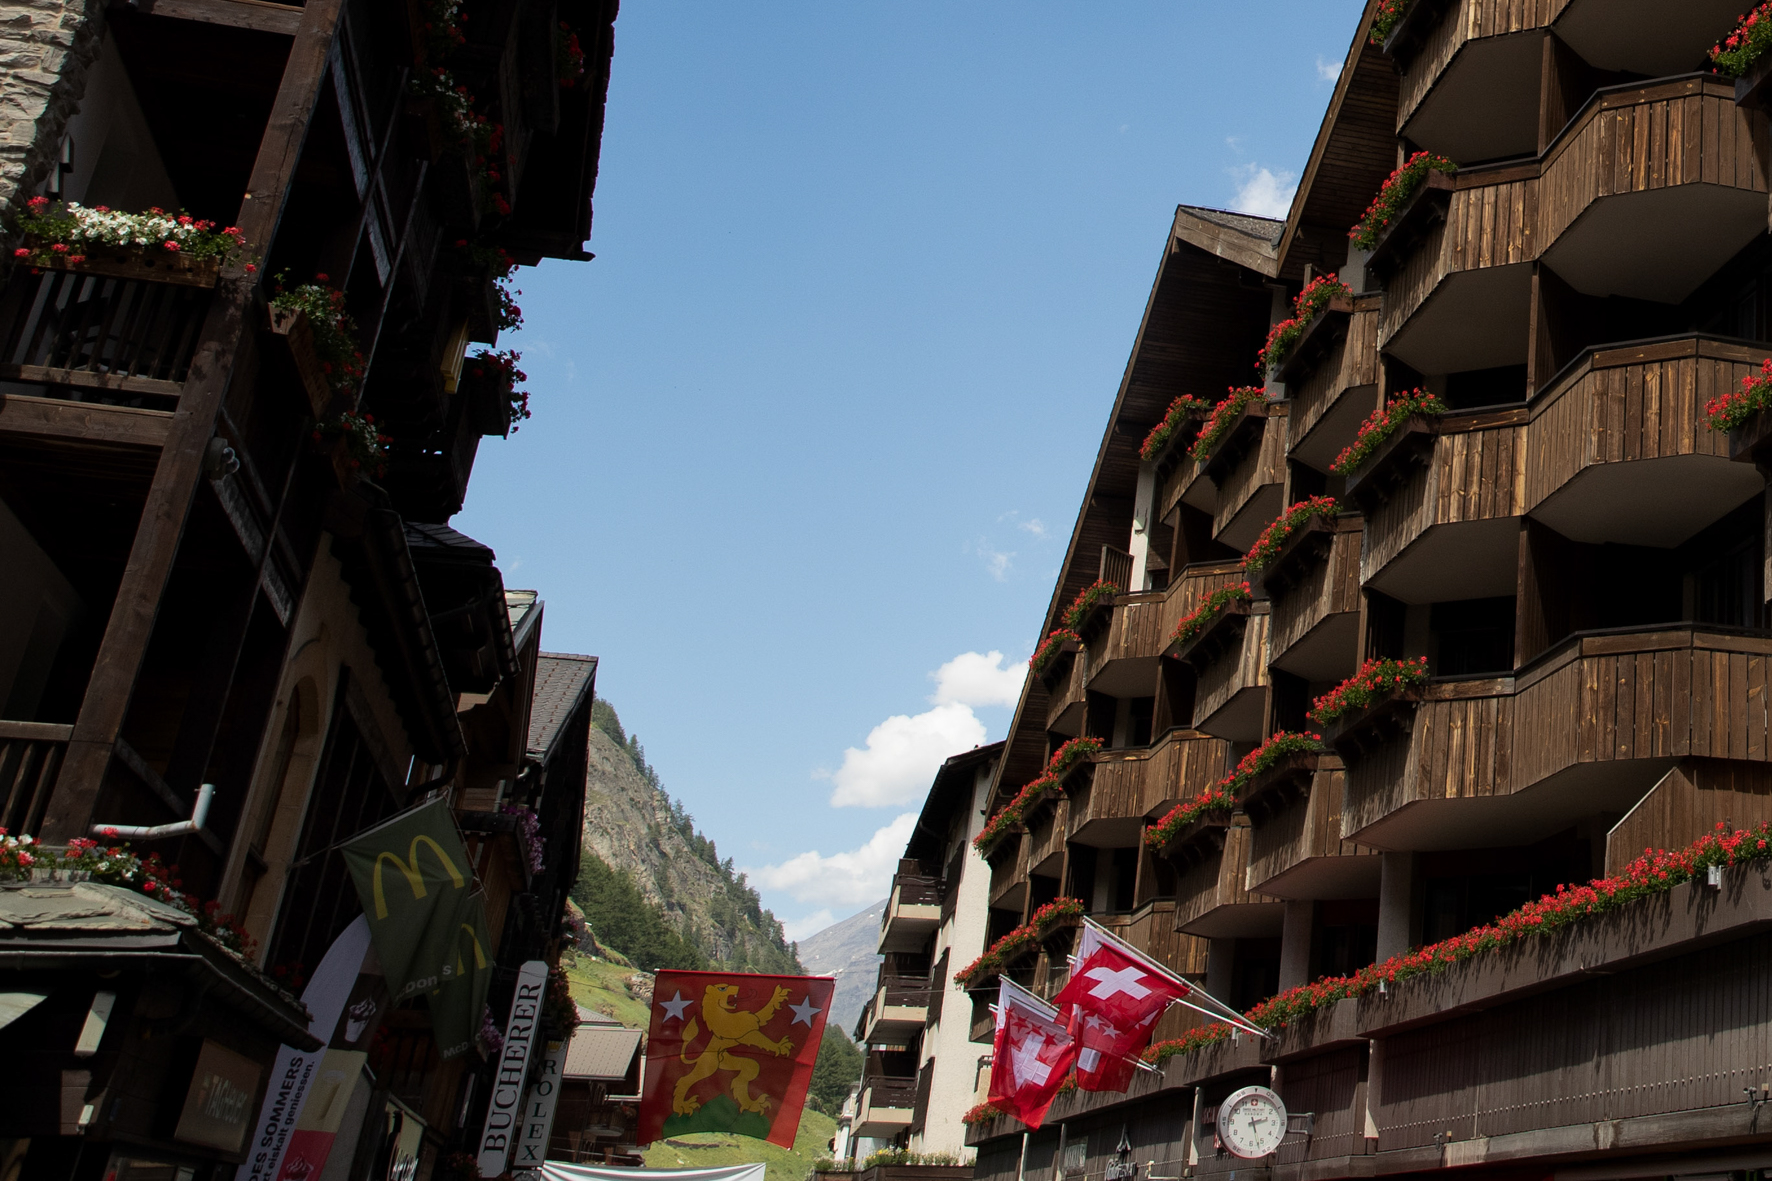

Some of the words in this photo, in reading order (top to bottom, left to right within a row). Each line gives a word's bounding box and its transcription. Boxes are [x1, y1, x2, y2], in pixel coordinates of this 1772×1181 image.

[262, 1057, 303, 1147] SOMMERS
[268, 1127, 289, 1169] eiskalt
[285, 1061, 315, 1125] geniessen.
[484, 982, 542, 1153] BUCHERER
[521, 1059, 557, 1160] ROLEX
